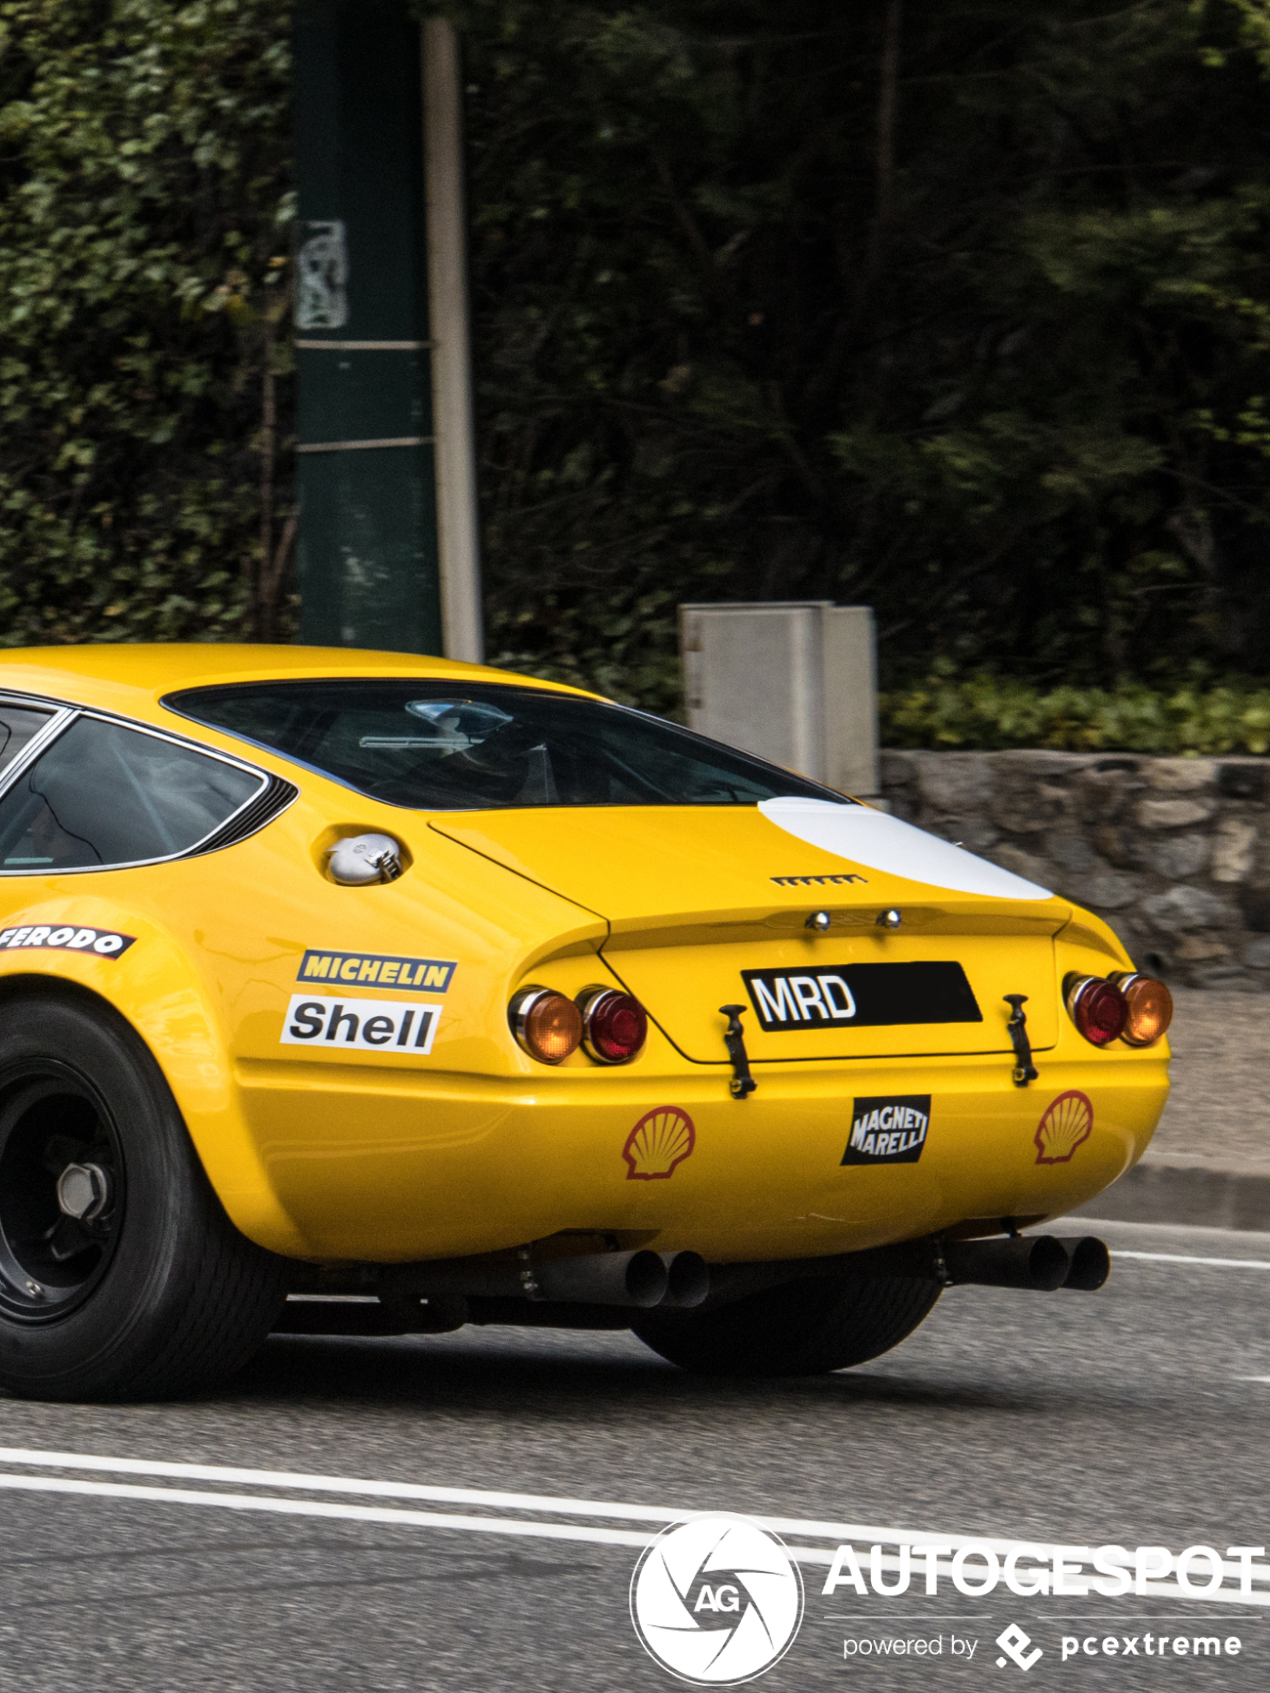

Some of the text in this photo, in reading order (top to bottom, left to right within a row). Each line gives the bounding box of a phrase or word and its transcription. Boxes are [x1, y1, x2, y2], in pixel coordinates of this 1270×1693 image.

[303, 955, 450, 988] MICHELIN
[750, 974, 857, 1023] MRD
[289, 1001, 434, 1048] Shell
[851, 1106, 928, 1133] MAGNETI
